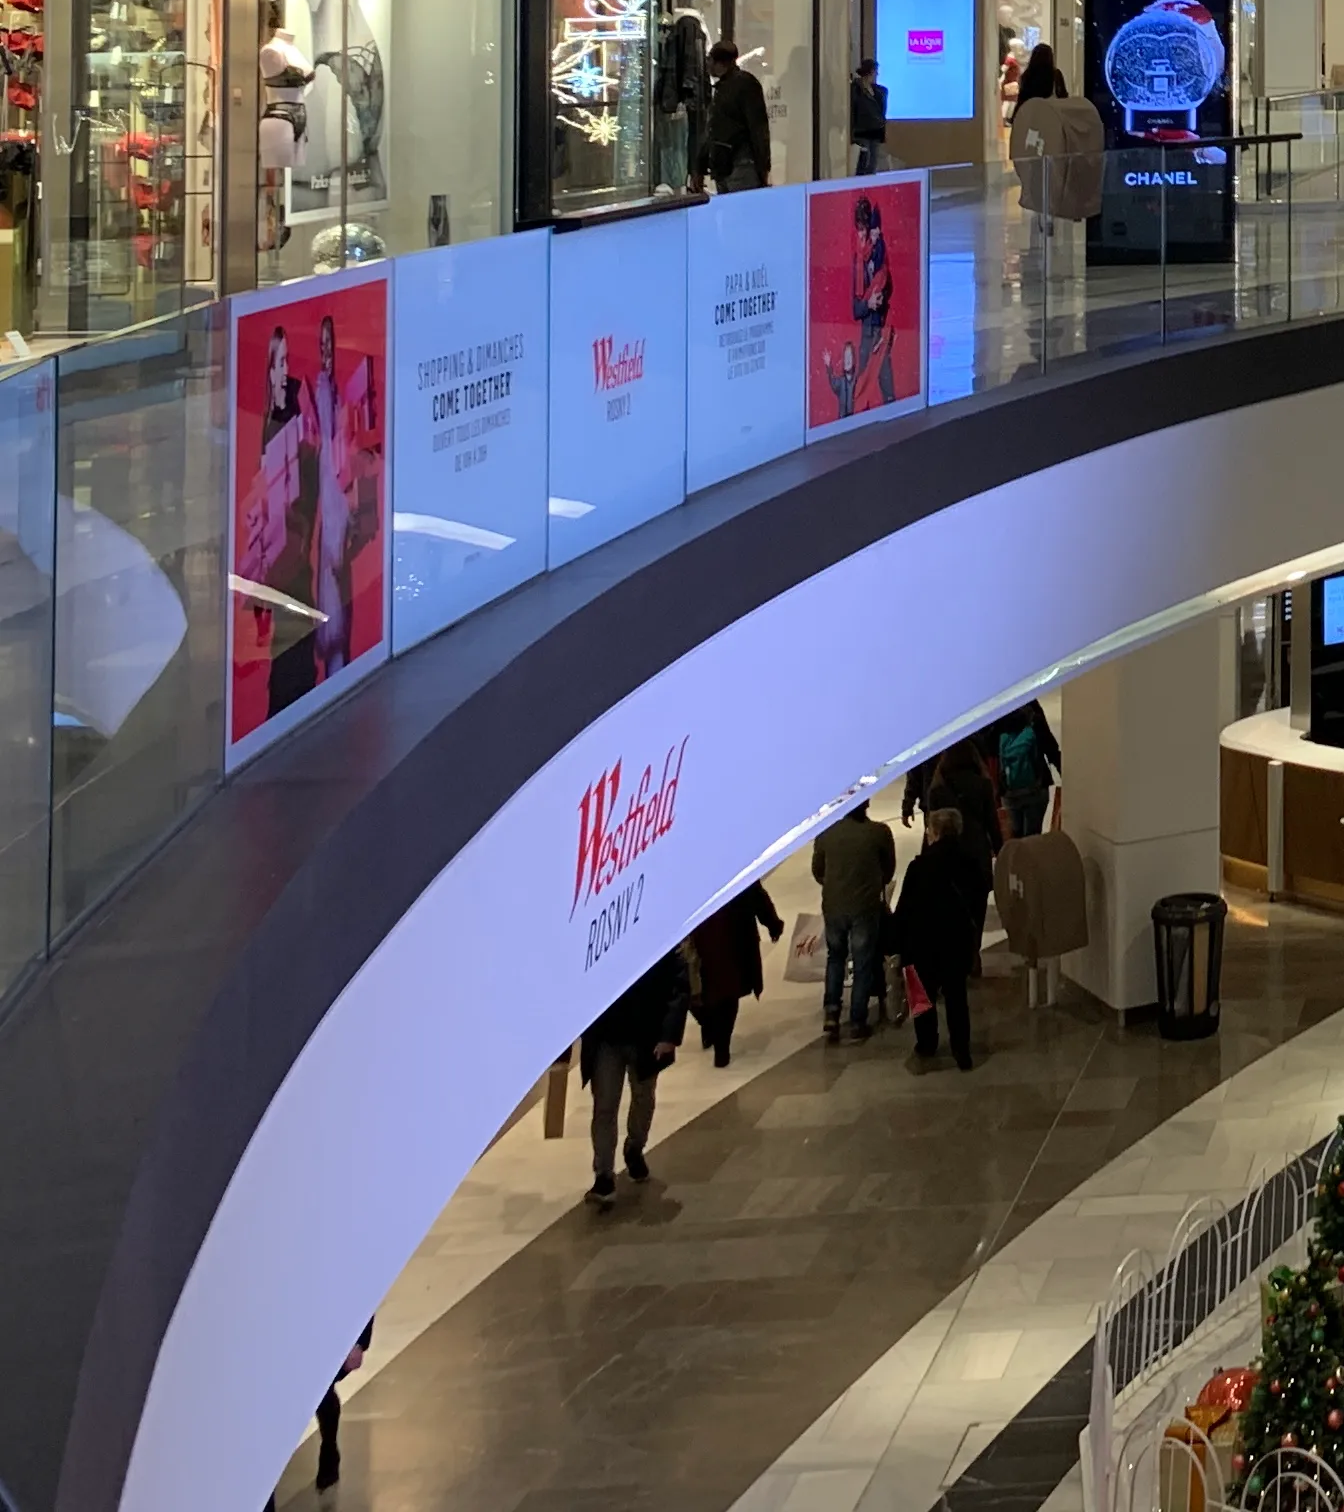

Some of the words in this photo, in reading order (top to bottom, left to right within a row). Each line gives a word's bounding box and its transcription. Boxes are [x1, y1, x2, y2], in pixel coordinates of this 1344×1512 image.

[1125, 172, 1197, 185] CHANEL
[714, 301, 736, 326] COME
[739, 291, 776, 320] TOGETHER
[417, 350, 465, 391] SHOPPING
[467, 347, 474, 375] &
[476, 333, 525, 373] DIMANCHES
[592, 333, 647, 395] Westfield
[432, 388, 460, 422] COME
[464, 371, 512, 411] TOGETHER
[569, 734, 690, 923] Westfield
[585, 881, 635, 973] ROSNY
[633, 873, 645, 925] 2
